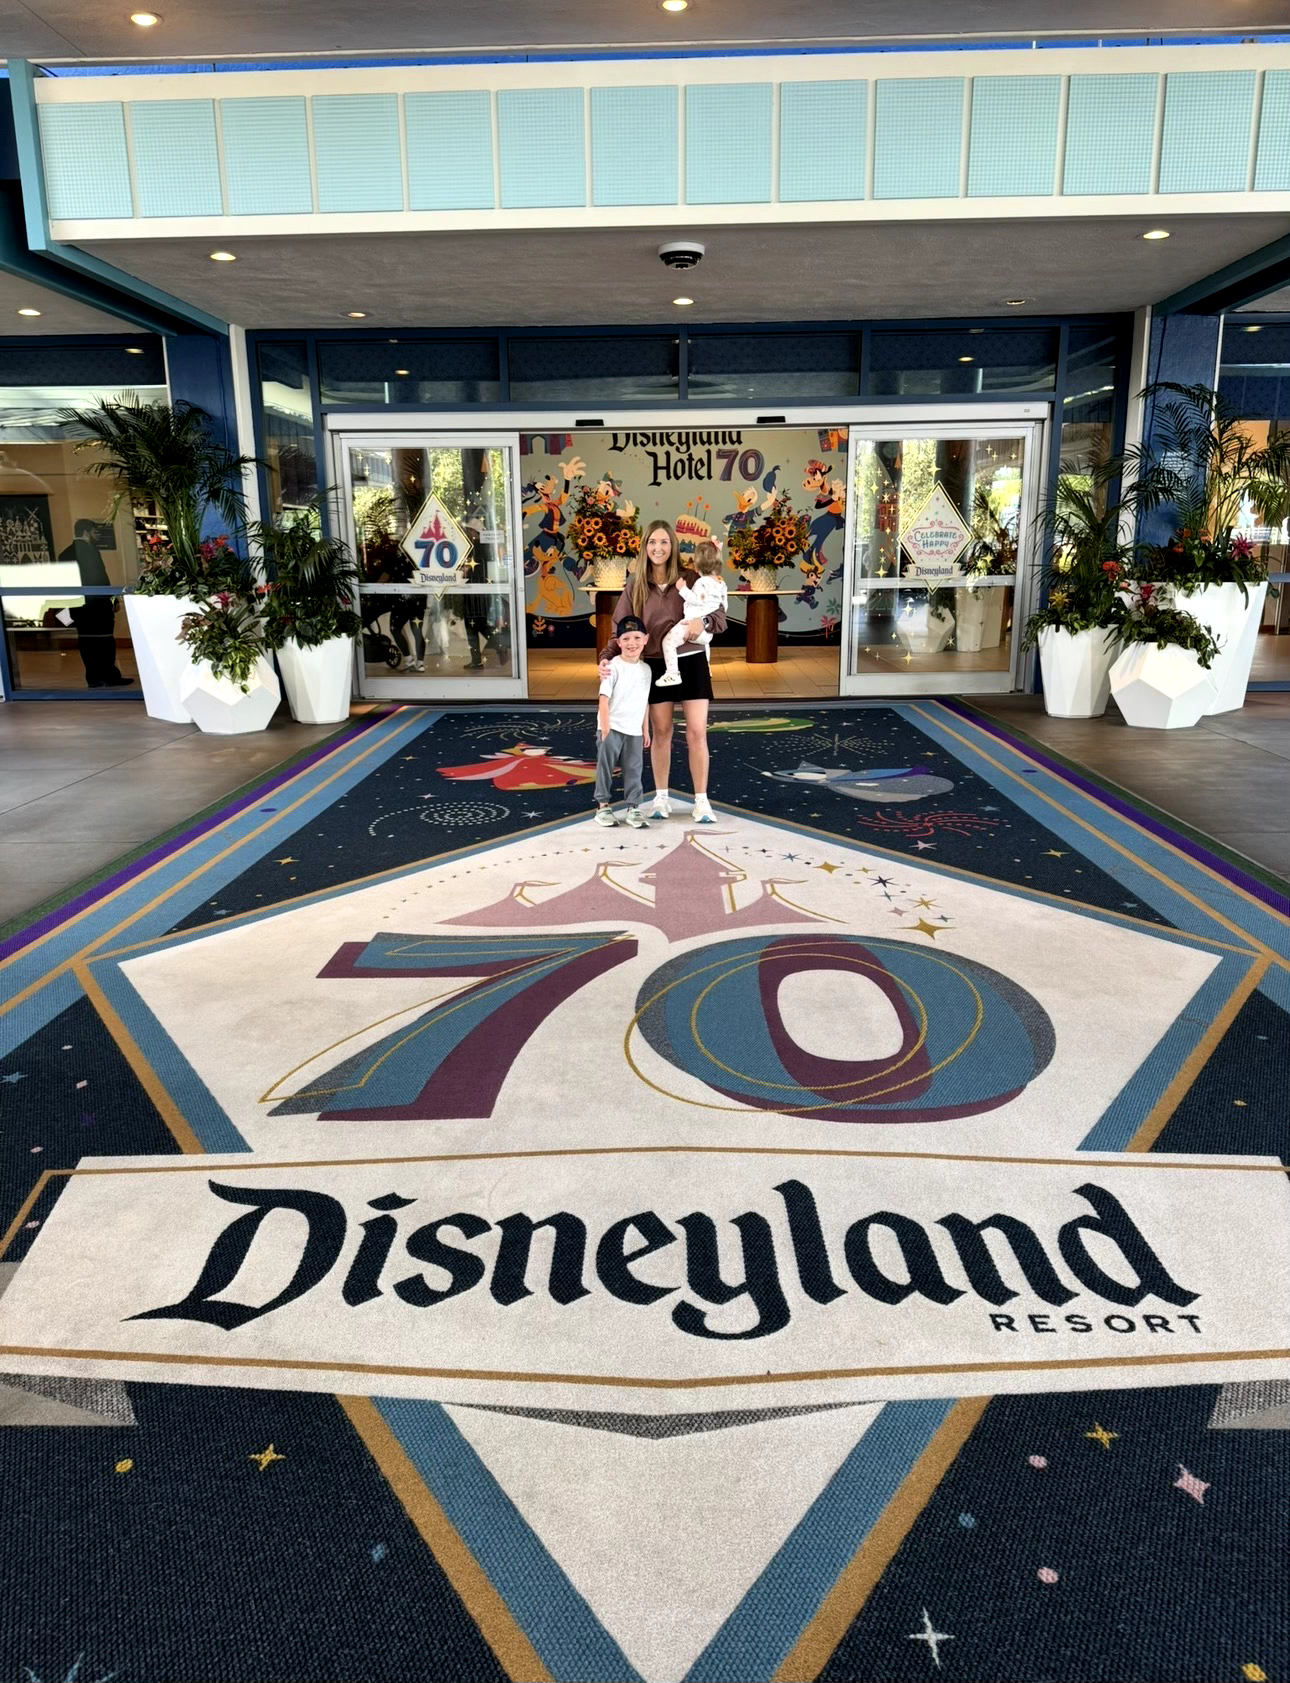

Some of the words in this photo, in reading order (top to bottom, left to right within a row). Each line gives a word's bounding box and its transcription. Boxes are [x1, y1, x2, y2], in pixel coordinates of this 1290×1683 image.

[645, 448, 713, 487] Hotel
[716, 448, 765, 482] 70
[414, 540, 458, 568] 70
[420, 573, 456, 583] Disneyland
[915, 566, 953, 576] Disneyland
[258, 930, 1056, 1123] 70
[121, 1179, 1202, 1340] Disneyland
[990, 1313, 1203, 1334] RESORT
